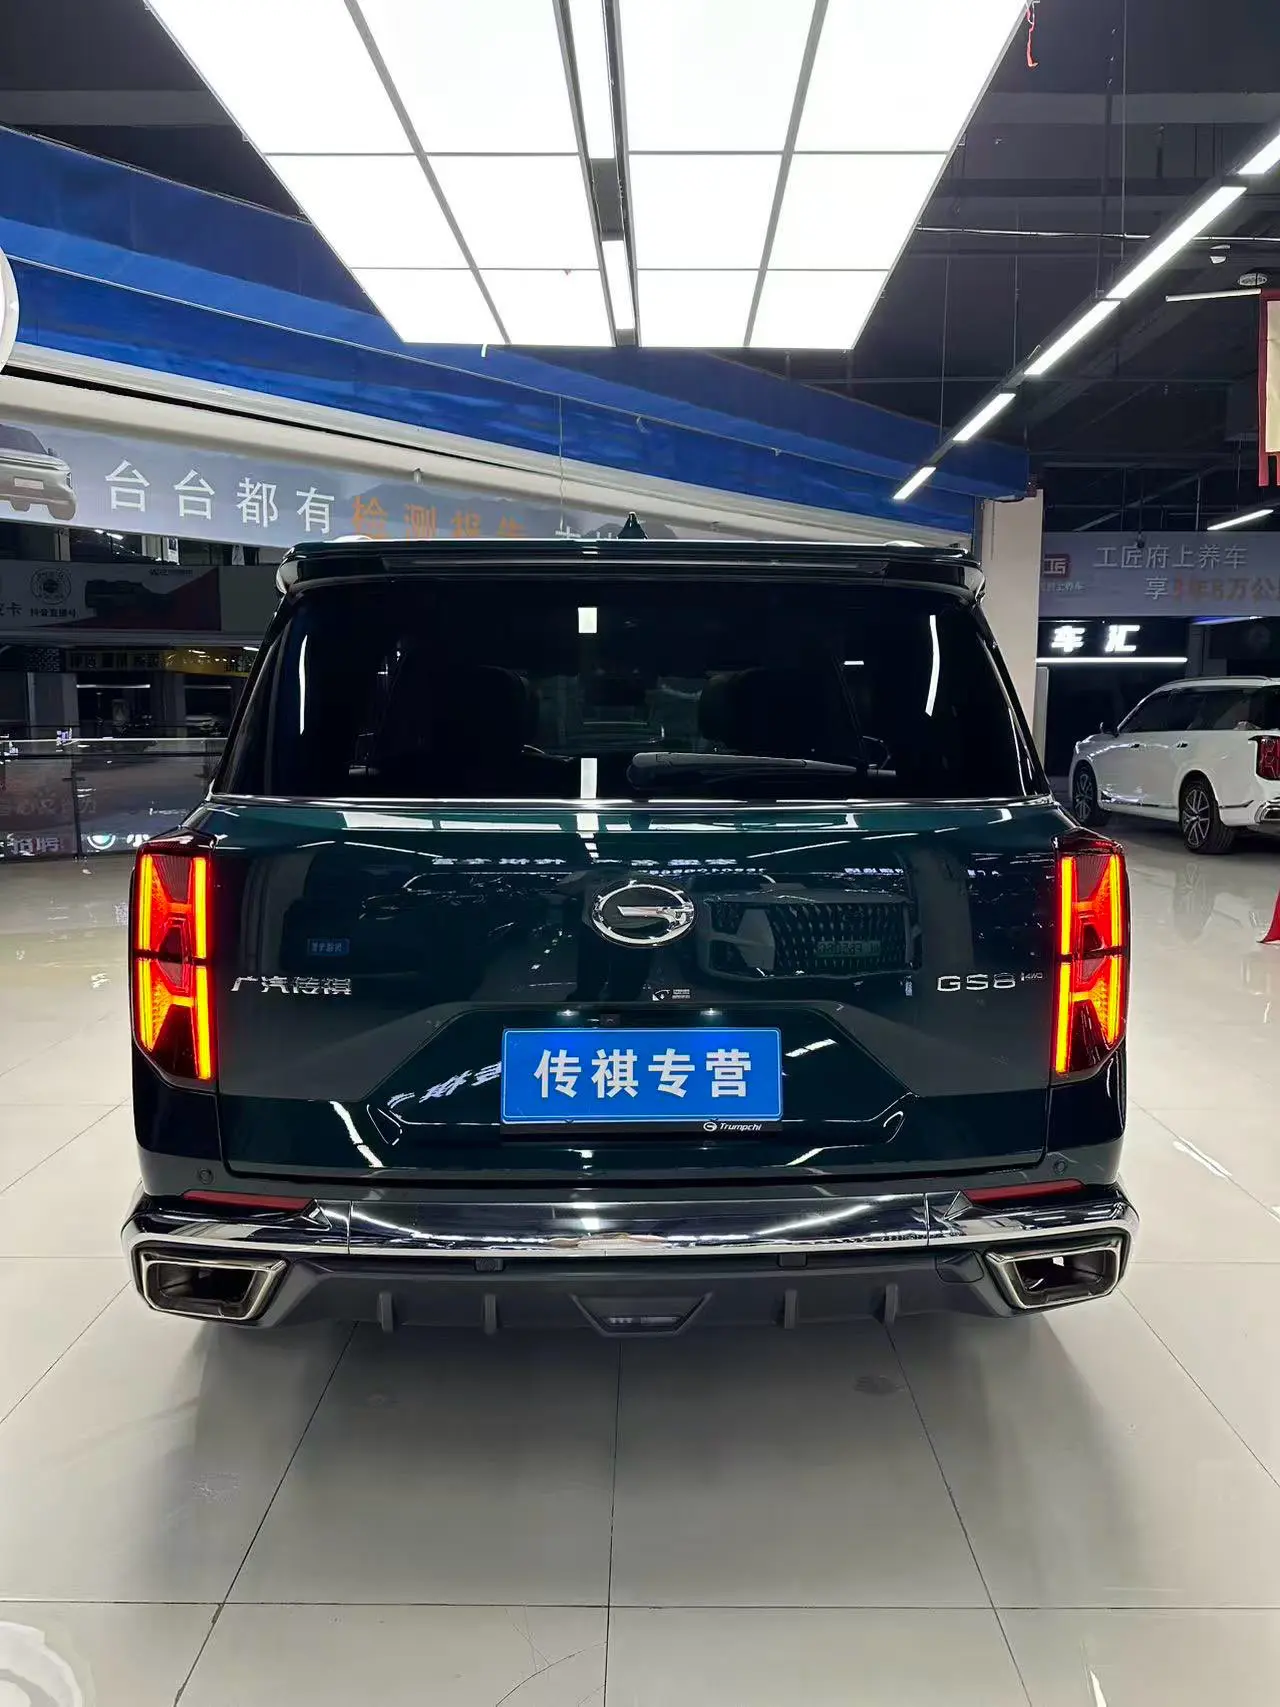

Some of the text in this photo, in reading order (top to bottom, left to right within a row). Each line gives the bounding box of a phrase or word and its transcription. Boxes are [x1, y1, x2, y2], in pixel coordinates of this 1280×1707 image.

[1094, 545, 1248, 569] 工匠府上养车
[231, 975, 353, 996] 广汽传祺
[937, 973, 1016, 992] GS8
[534, 1049, 751, 1098] 传祺专营
[719, 1122, 760, 1134] Trumpchi
